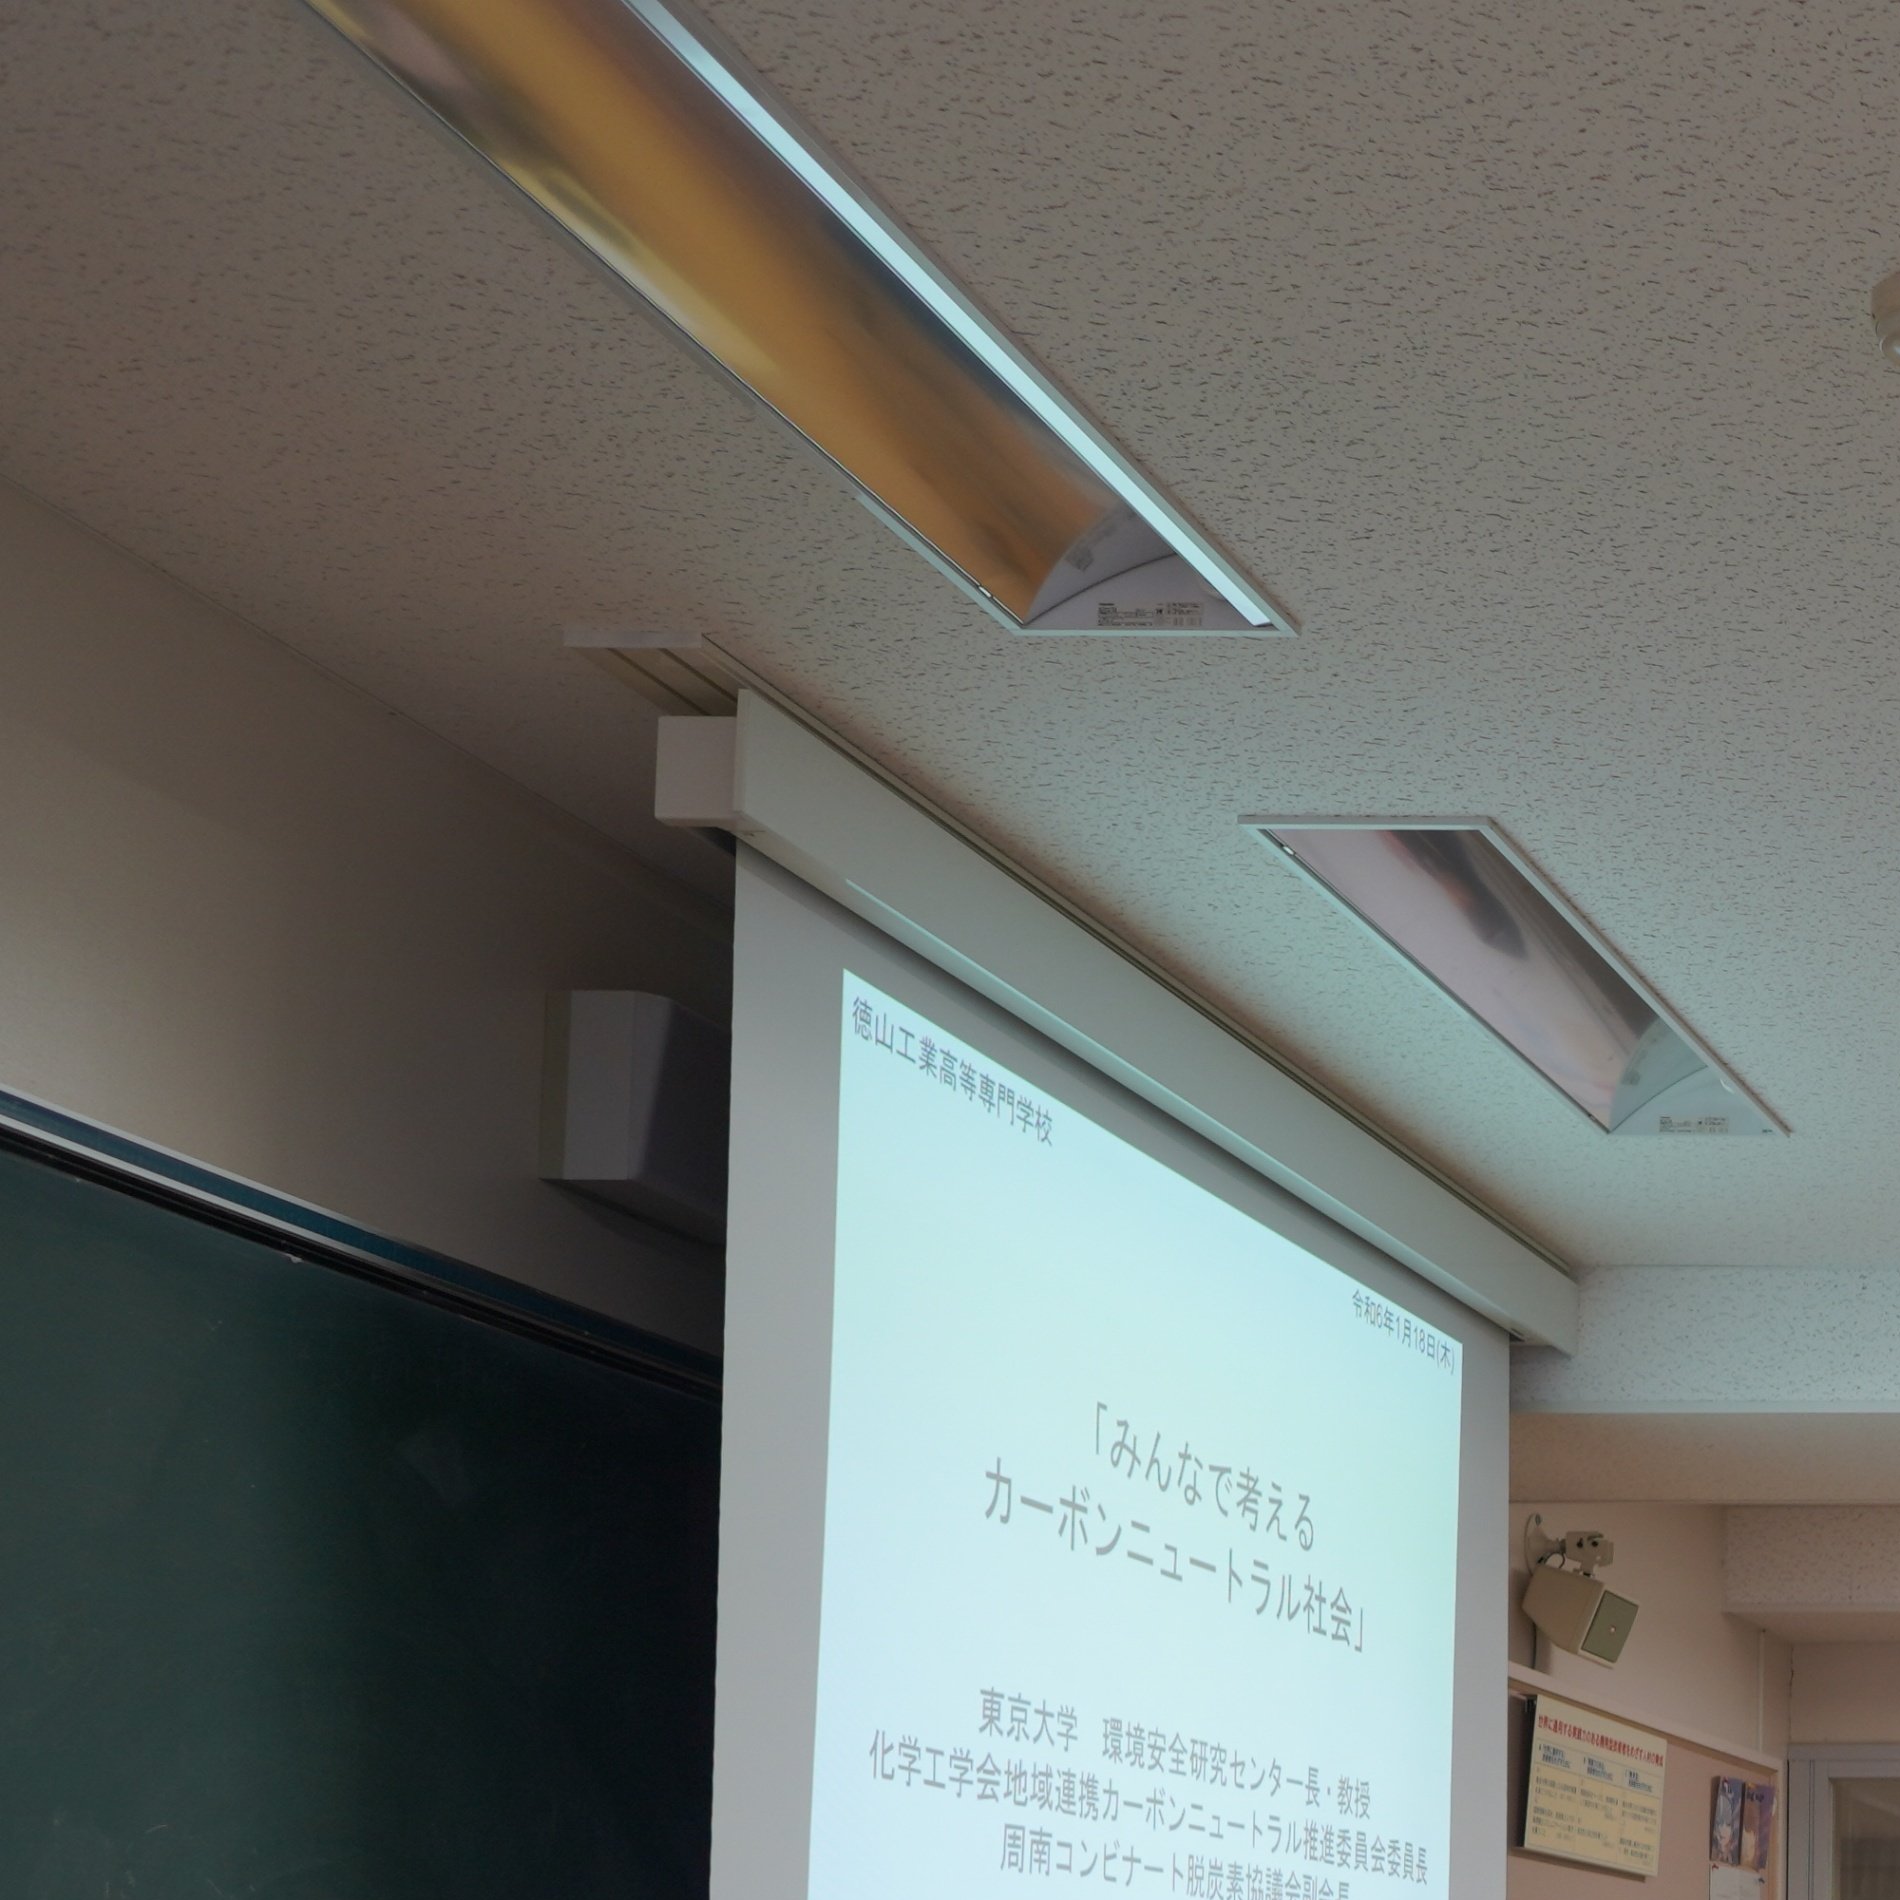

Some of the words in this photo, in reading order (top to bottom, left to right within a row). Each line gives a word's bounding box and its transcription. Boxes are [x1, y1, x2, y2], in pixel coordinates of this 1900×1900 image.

[852, 996, 1053, 1146] 徳山工業高等専門学校
[1352, 1289, 1456, 1374] 令和6年1月18日(木)
[1095, 1401, 1314, 1551] 「みんなで考える
[985, 1456, 1364, 1652] カーボンニュートラル社会」
[870, 1729, 1428, 1885] 化学工学会地域連携カーボンニュートラル推進委員会委員長
[979, 1686, 1078, 1752] 東京大学
[1102, 1717, 1371, 1820] 環境安全研究センター長・教授
